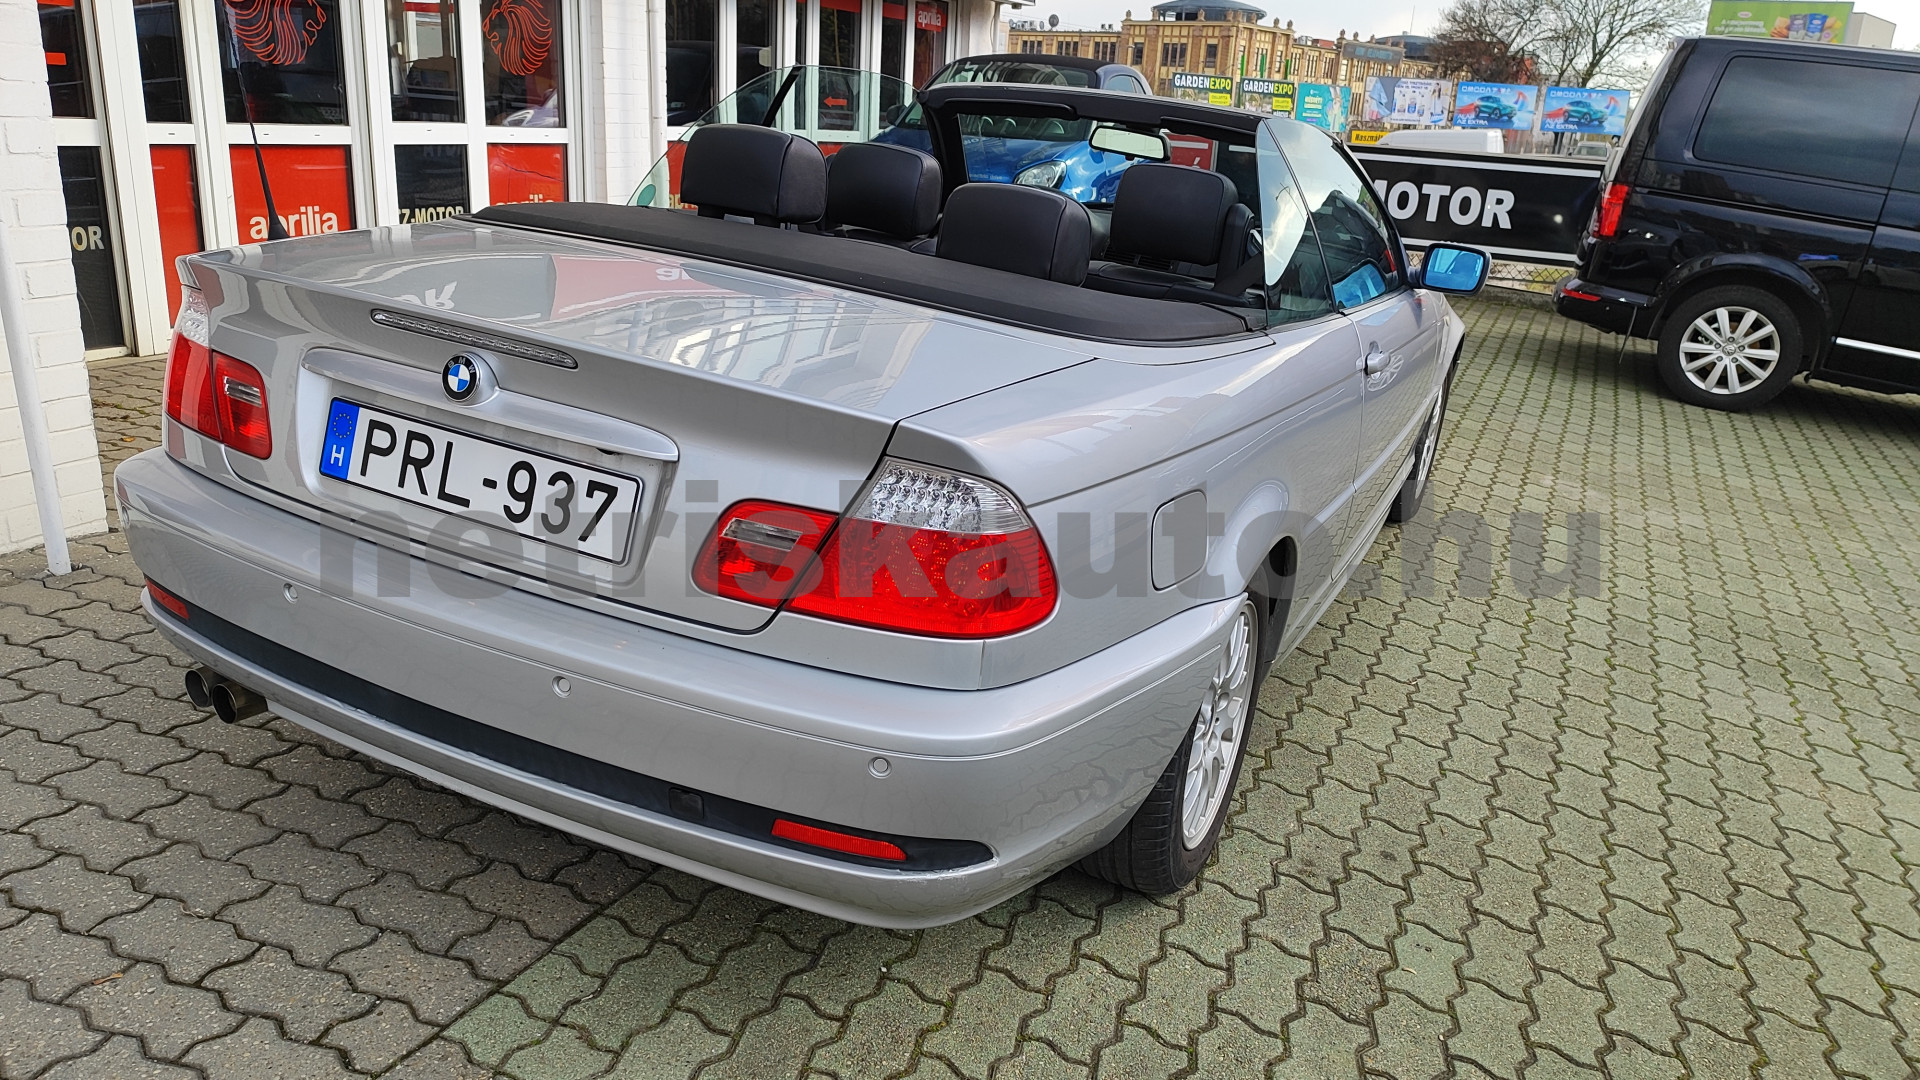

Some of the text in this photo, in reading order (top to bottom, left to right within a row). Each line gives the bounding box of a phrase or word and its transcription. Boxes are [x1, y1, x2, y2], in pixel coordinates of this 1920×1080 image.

[447, 356, 476, 374] BMW
[330, 444, 345, 467] H
[359, 418, 619, 542] PRL-937
